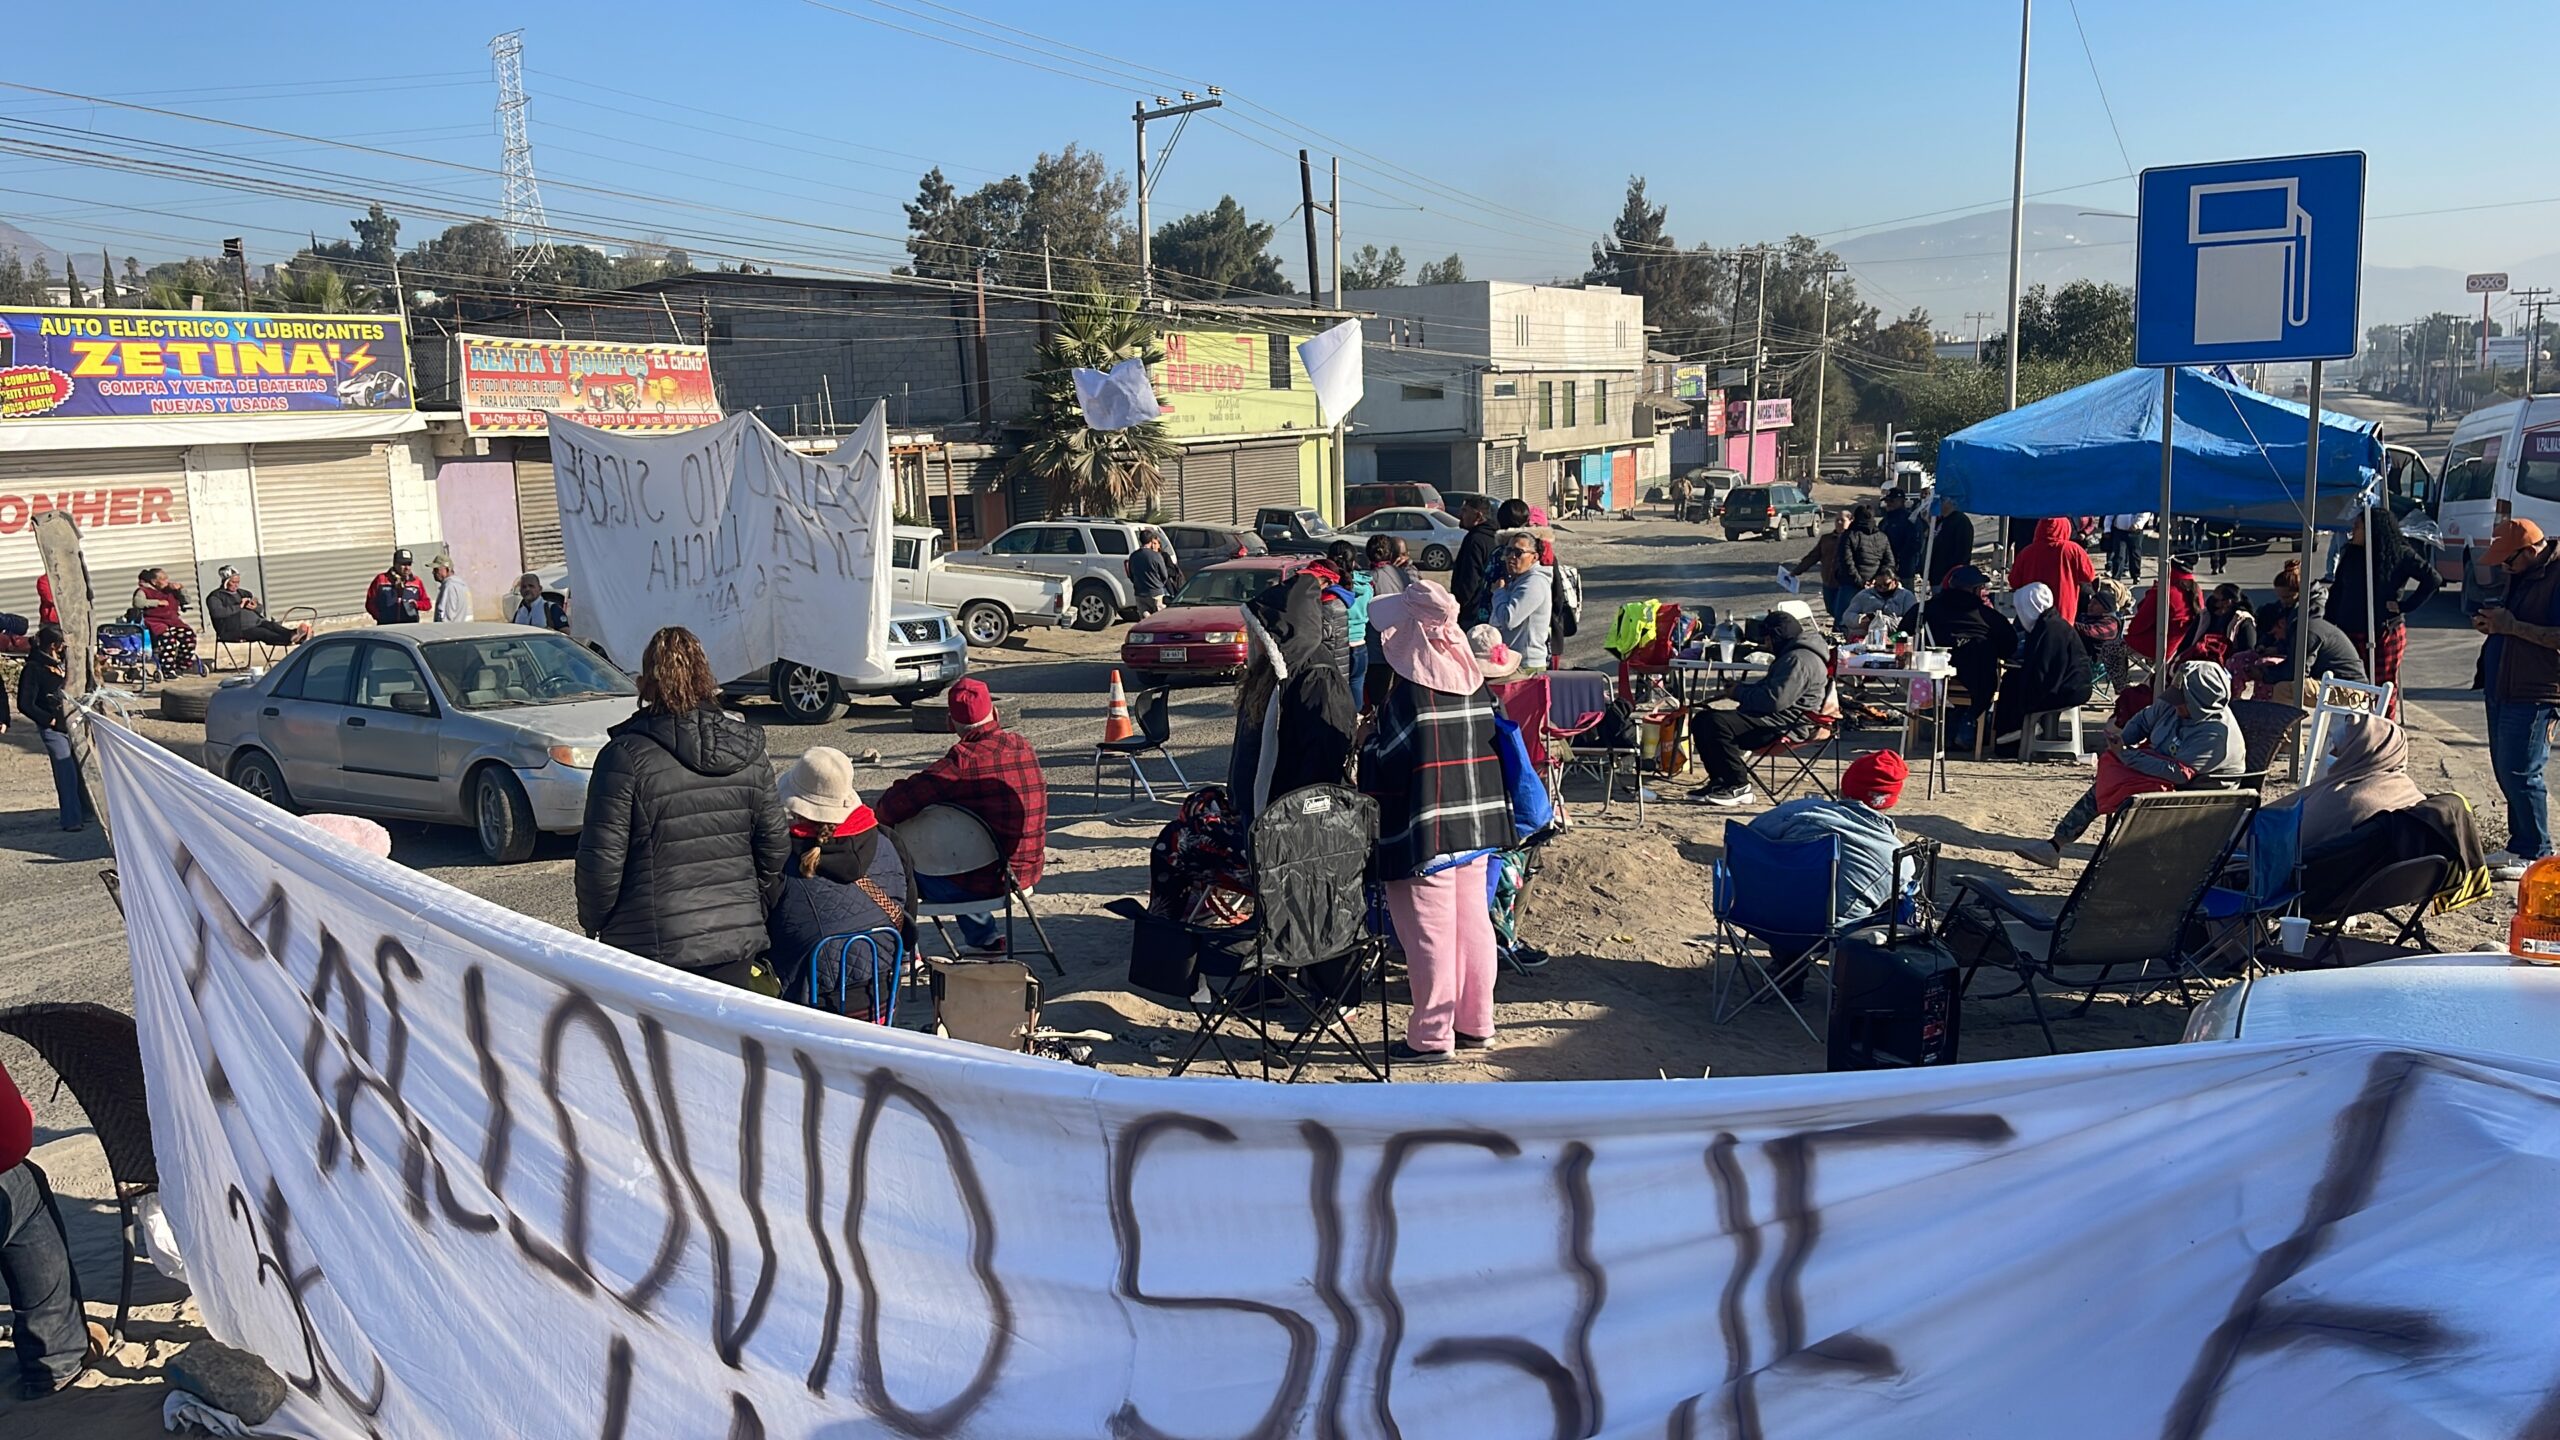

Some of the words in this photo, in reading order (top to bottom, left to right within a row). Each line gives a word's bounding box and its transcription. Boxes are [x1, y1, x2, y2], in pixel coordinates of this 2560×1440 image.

[2468, 276, 2507, 289] OXXO
[40, 317, 103, 336] AUTO
[108, 319, 229, 338] ELECTRICO
[234, 320, 248, 338] Y
[254, 322, 385, 340] LUBRICANTES
[469, 346, 546, 373] RENTA
[548, 349, 564, 373] Y
[567, 350, 649, 378] EQUIPOS
[4, 372, 40, 387] COMPRA
[40, 371, 51, 381] DE
[1167, 363, 1245, 393] REFUGIO
[23, 387, 29, 397] Y
[29, 384, 57, 397] FILTRO
[98, 380, 169, 396] COMPRA
[169, 380, 182, 395] Y
[183, 379, 236, 395] VENTA
[237, 379, 258, 394] DE
[259, 378, 327, 394] BATERIAS
[470, 379, 480, 392] DE
[481, 379, 499, 392] TODO
[501, 380, 511, 392] UN
[512, 380, 530, 393] POCO
[532, 381, 541, 393] EN
[543, 381, 566, 394] EQUIPO
[25, 397, 55, 410] GRATIS
[151, 398, 214, 414] NUEVAS
[217, 398, 229, 413] Y
[230, 397, 290, 412] USADAS
[480, 395, 498, 408] PARA
[500, 396, 509, 408] LA
[517, 413, 532, 425] 664
[588, 414, 602, 425] 664
